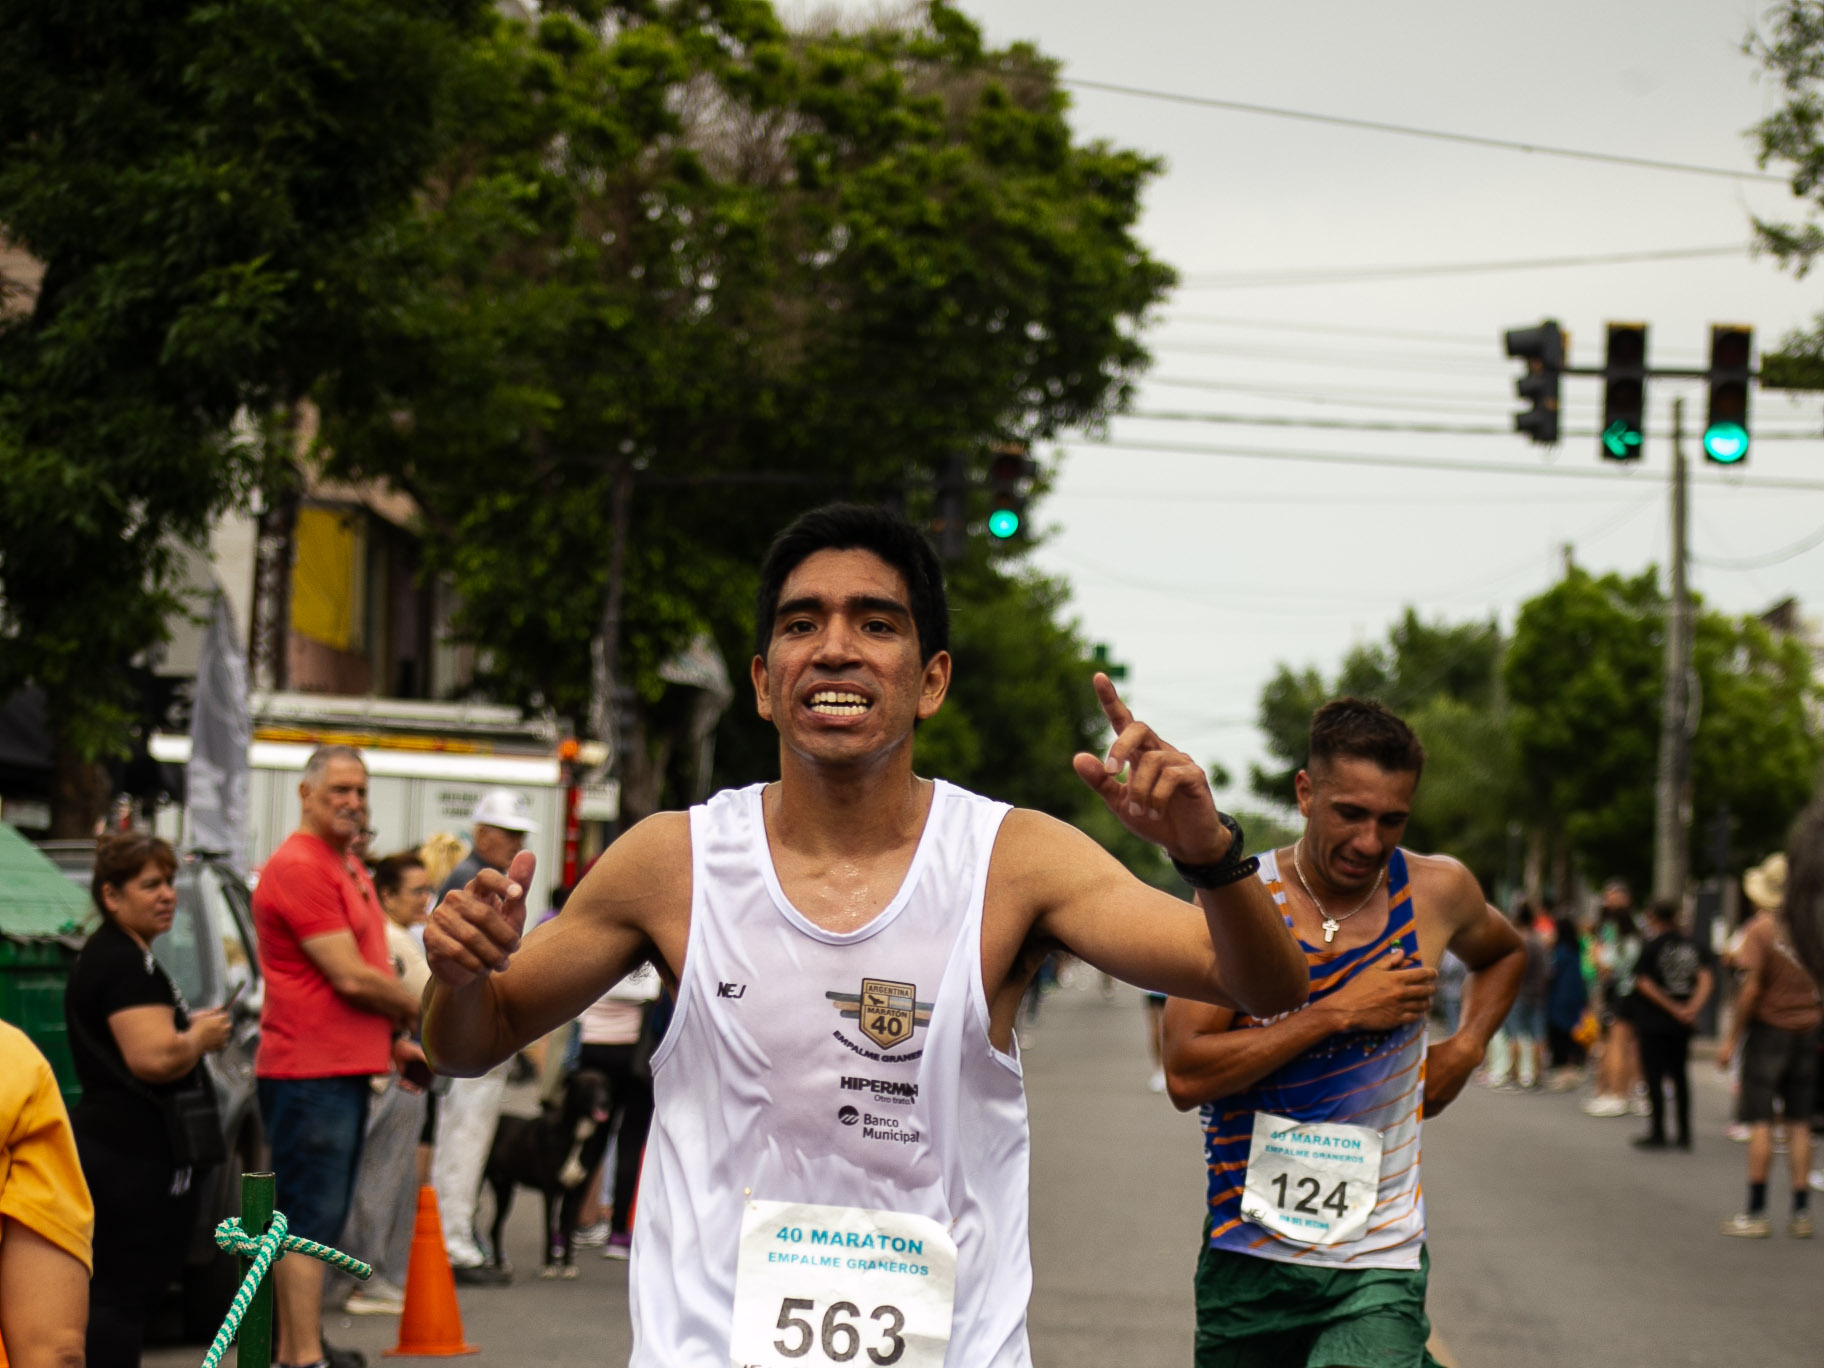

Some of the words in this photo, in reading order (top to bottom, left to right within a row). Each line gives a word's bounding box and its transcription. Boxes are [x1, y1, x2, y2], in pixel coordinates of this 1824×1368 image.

[717, 982, 747, 999] NEJ
[868, 985, 909, 997] ARGENTINA
[871, 1016, 902, 1036] 40
[833, 1030, 880, 1061] EMPALME
[874, 1094, 891, 1103] Otro
[864, 1113, 899, 1127] Banco
[863, 1127, 919, 1144] Municipal
[1270, 1131, 1286, 1141] 40
[1291, 1133, 1361, 1150] MARATON
[1265, 1145, 1309, 1158] EMPALME
[1312, 1151, 1364, 1164] GRANEROS
[1271, 1172, 1349, 1218] 124
[776, 1227, 803, 1243] 40
[811, 1229, 923, 1255] MARATON
[768, 1252, 841, 1268] EMPALME
[846, 1258, 929, 1276] GRANEROS
[773, 1297, 906, 1366] 563
